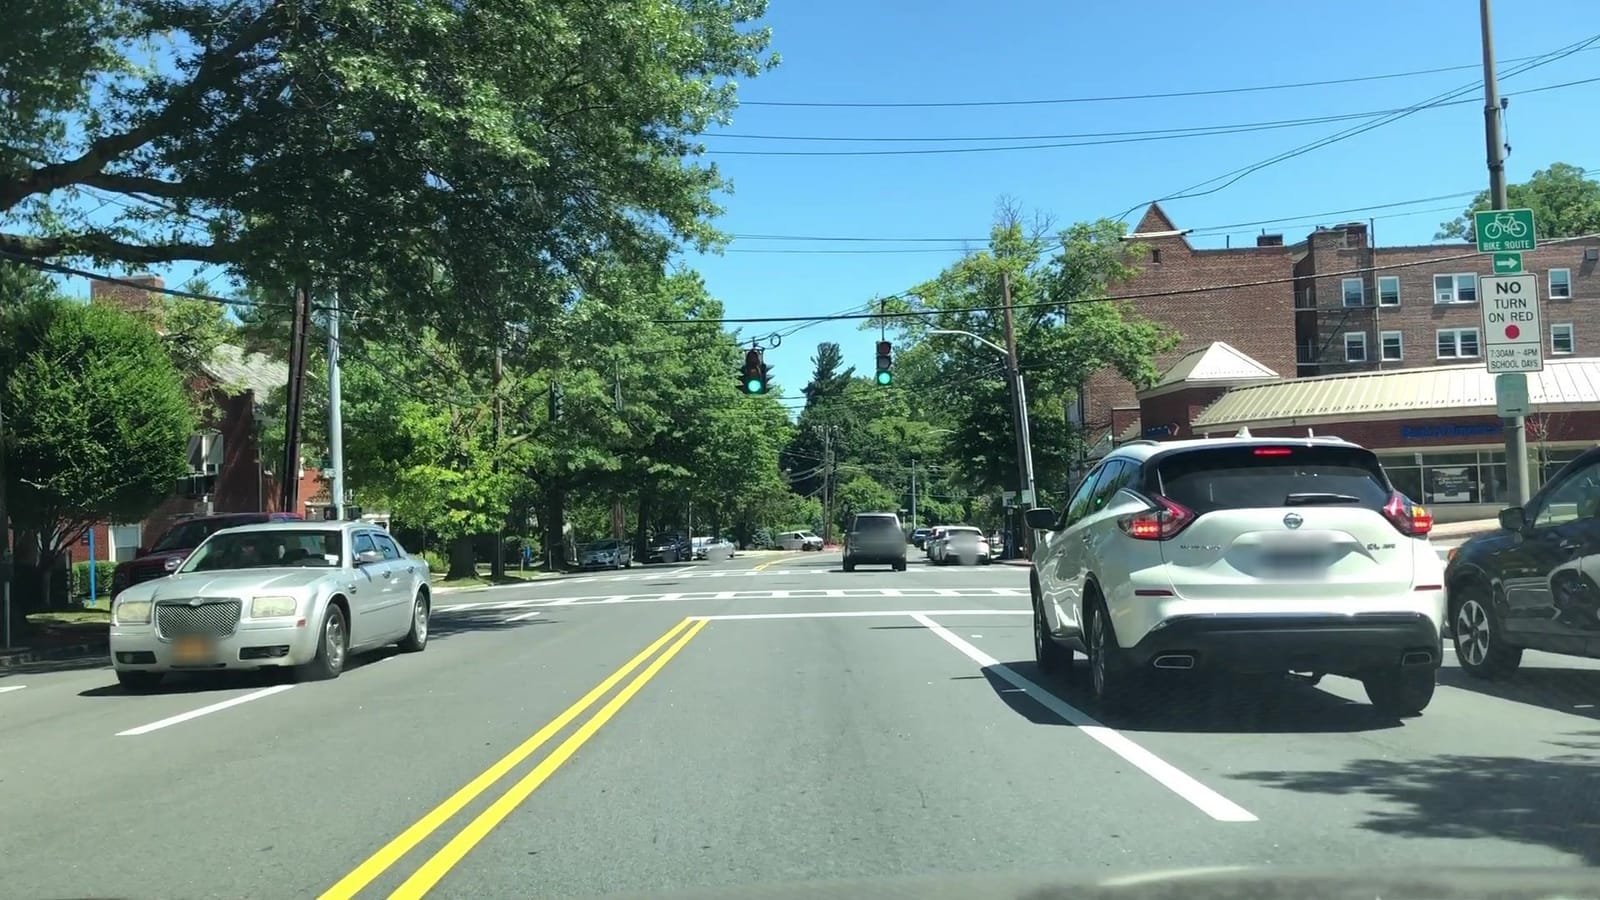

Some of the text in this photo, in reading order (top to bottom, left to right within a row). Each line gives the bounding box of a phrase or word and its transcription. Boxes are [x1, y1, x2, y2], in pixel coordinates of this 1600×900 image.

[1483, 240, 1530, 250] BIKE ROUTE
[1496, 281, 1521, 294] NO
[1494, 298, 1527, 309] TURN
[1488, 311, 1534, 322] ON RED
[1523, 348, 1538, 356] 4PM
[1490, 359, 1538, 369] SCHOOL DAYS
